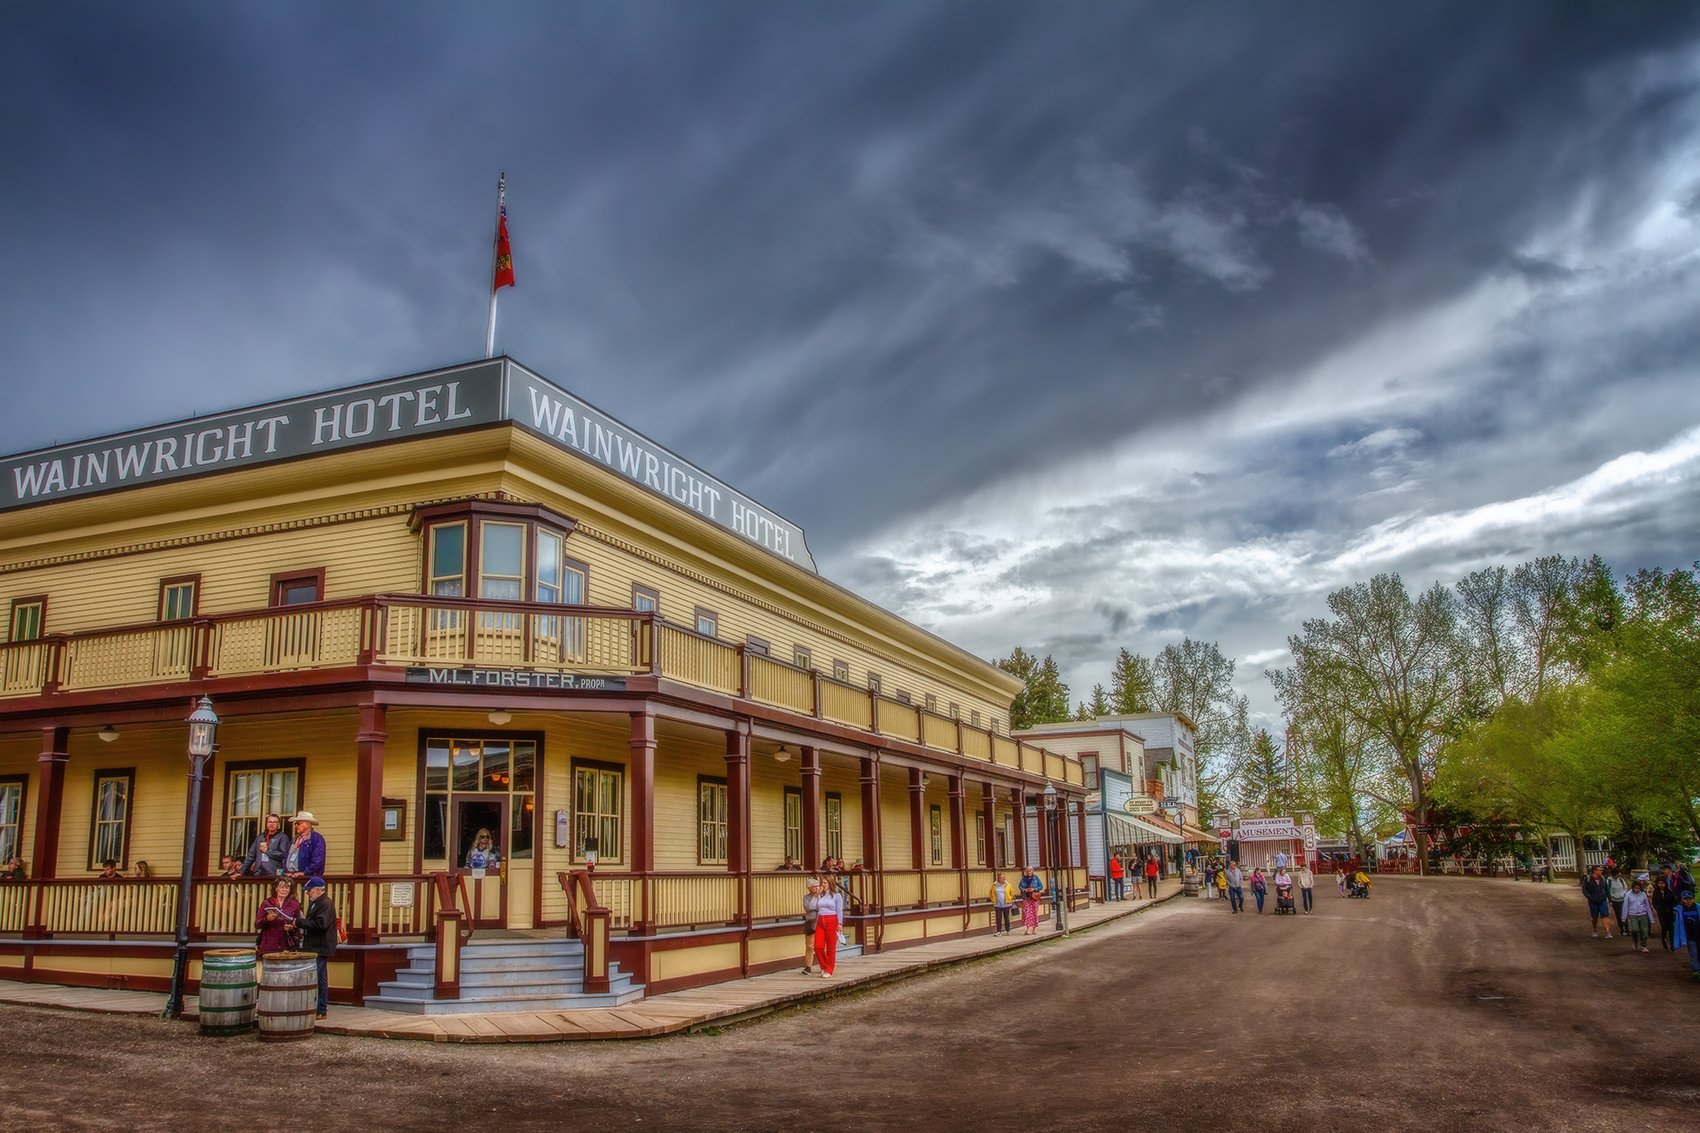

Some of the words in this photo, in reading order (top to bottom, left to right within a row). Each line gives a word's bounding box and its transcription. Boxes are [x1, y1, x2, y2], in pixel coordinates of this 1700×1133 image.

[13, 415, 290, 499] WAINWRIGHT
[311, 381, 472, 446] HOTEL
[528, 386, 721, 520] WAINWRIGHT
[731, 499, 795, 561] HOTEL
[1235, 827, 1302, 839] AMUSEMENTS
